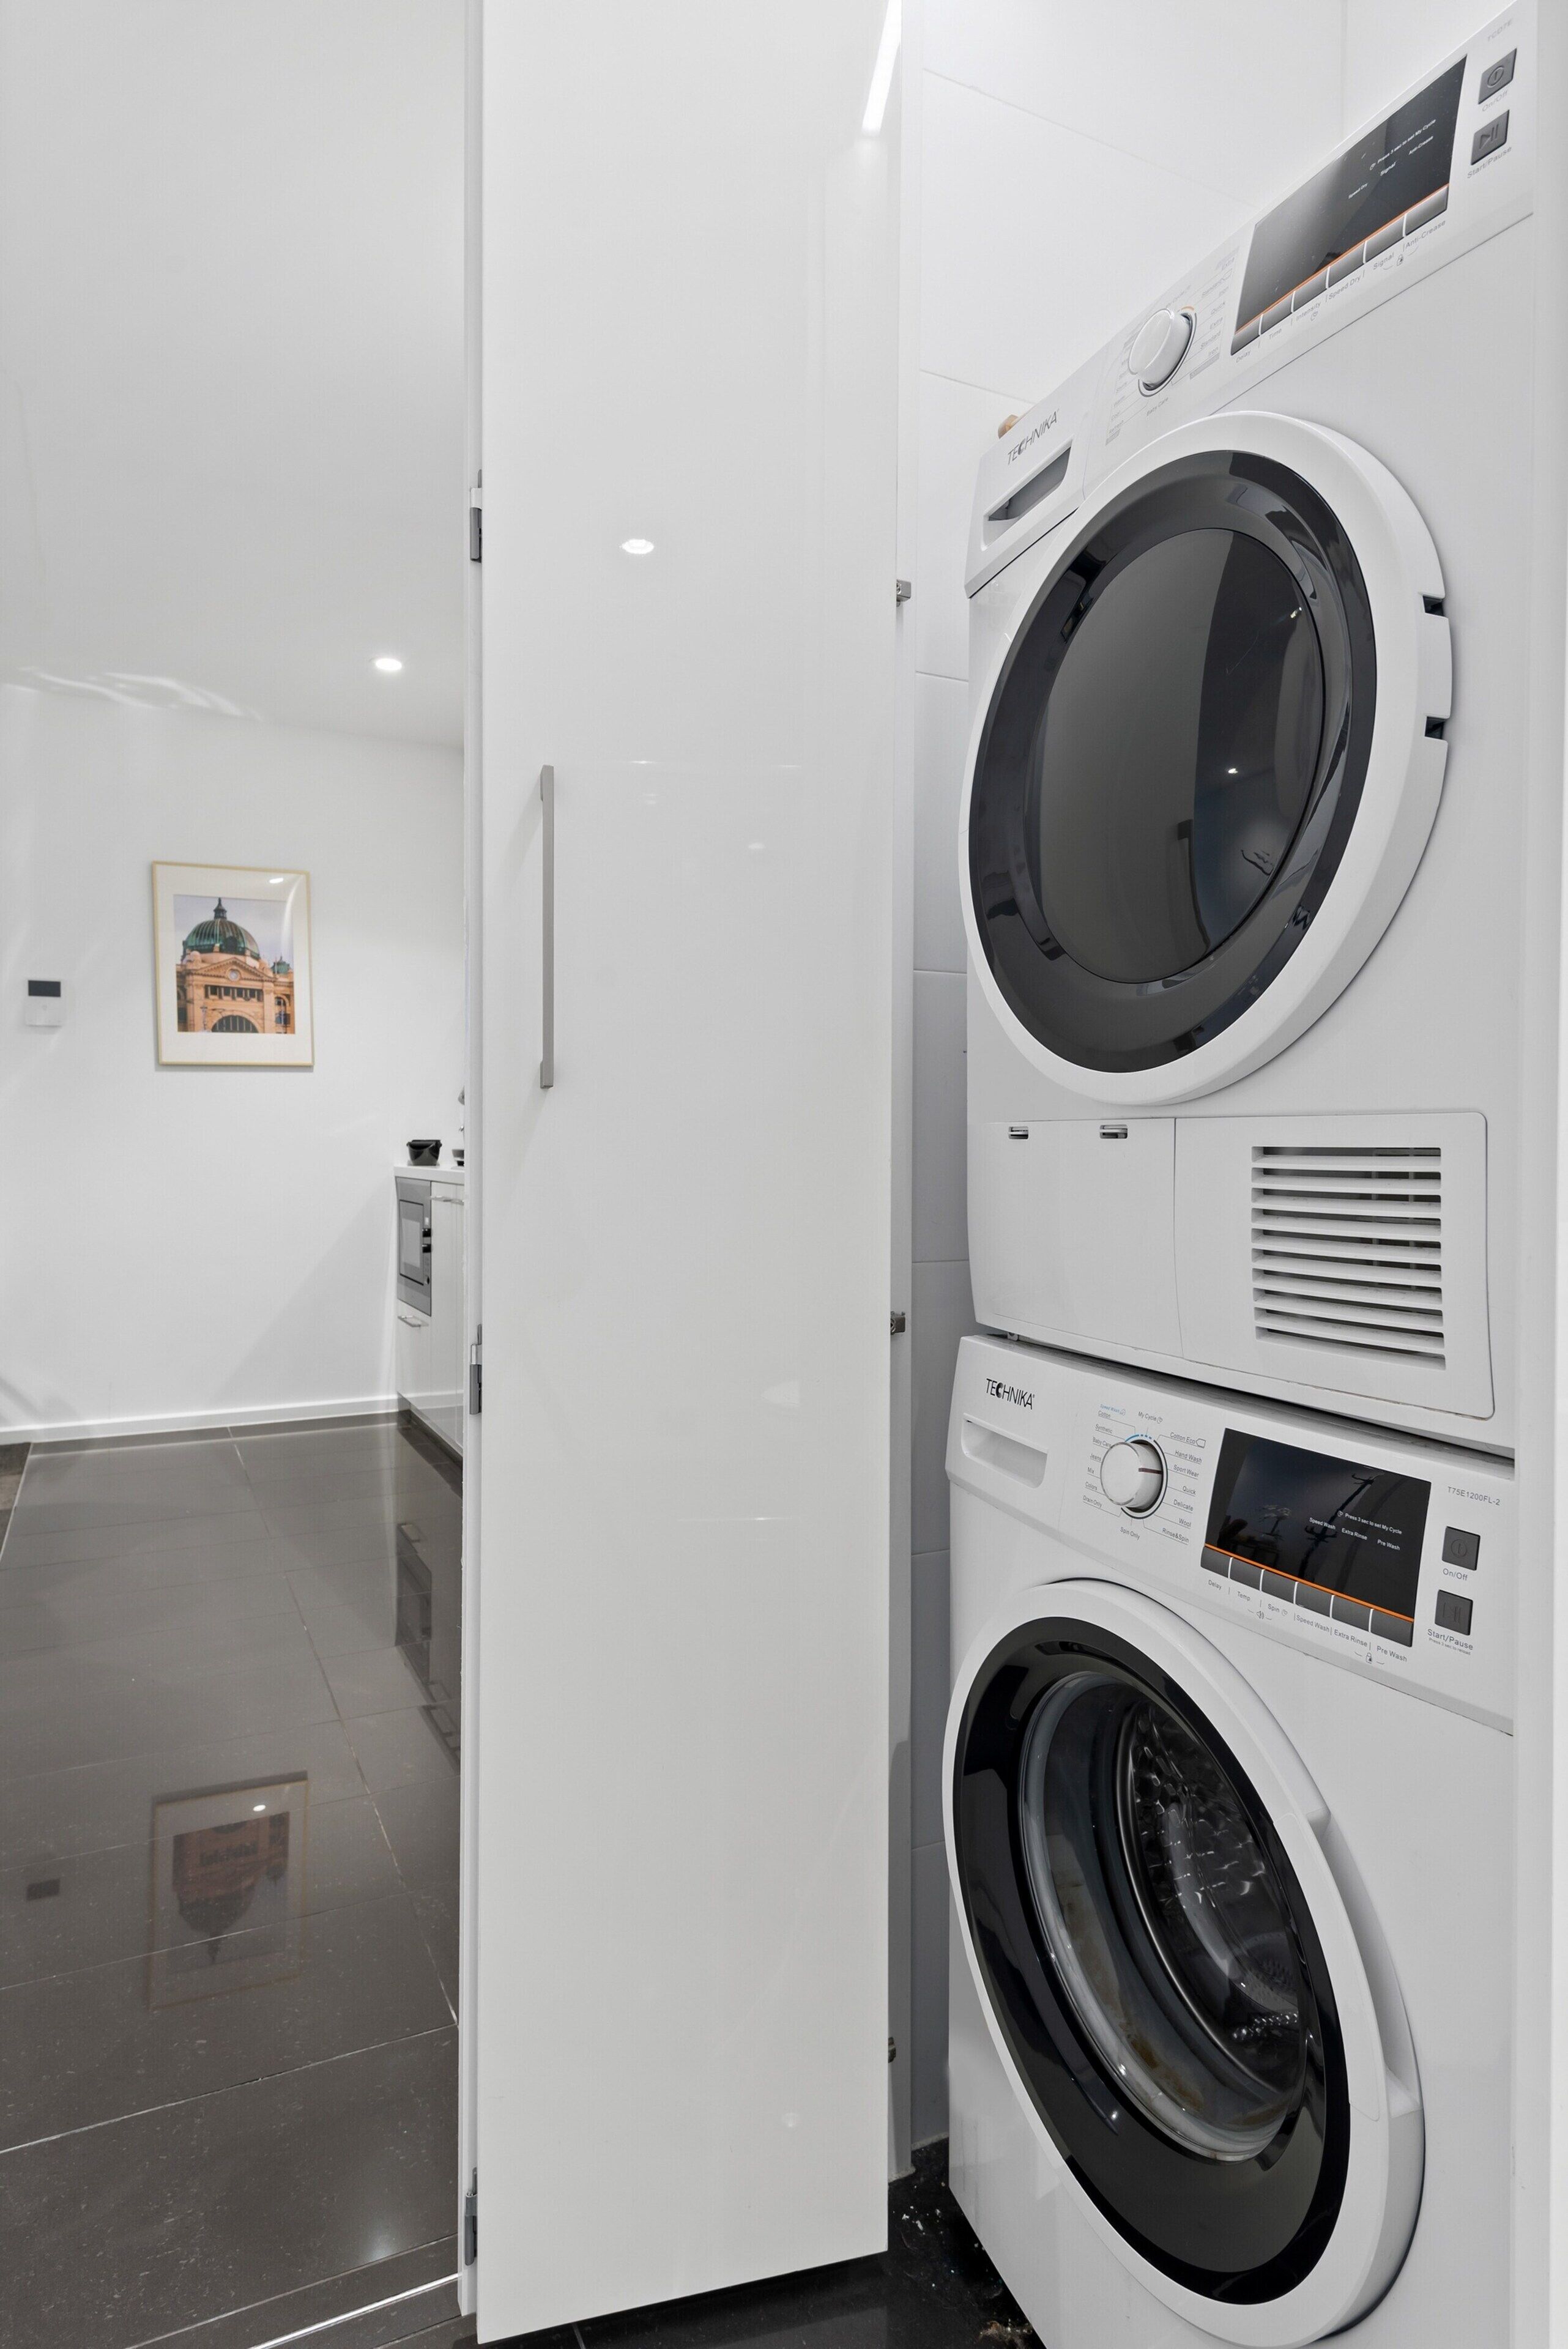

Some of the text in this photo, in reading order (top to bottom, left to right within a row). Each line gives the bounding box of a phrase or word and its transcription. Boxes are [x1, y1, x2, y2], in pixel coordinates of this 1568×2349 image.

[1482, 90, 1508, 112] On/Off
[1467, 146, 1512, 179] Start/Pause
[1405, 220, 1446, 249] Anti-Crease
[1373, 252, 1394, 270] Signal
[1329, 275, 1361, 300] Speed Dry
[1296, 301, 1321, 321] Intensity
[1269, 328, 1282, 340] Time
[1236, 351, 1251, 363] Delay
[1008, 410, 1057, 466] TECHNIKA
[986, 1378, 1033, 1410] TECHNIKA
[1098, 1410, 1111, 1419] Cotton
[1145, 1413, 1157, 1422] Cycle
[1095, 1423, 1113, 1434] Synthetic
[1093, 1436, 1102, 1446] Baby
[1170, 1432, 1185, 1442] Cotton
[1090, 1453, 1101, 1462] Jeans
[1175, 1450, 1202, 1463] Hand Wash
[1173, 1464, 1200, 1478] Sport Wear
[1085, 1482, 1098, 1491] Colors
[1183, 1485, 1196, 1495] Quick
[1083, 1494, 1102, 1508] Drain Only
[1447, 1486, 1500, 1505] T75E1200FL-2
[1173, 1499, 1194, 1512] Delicate
[1178, 1518, 1192, 1527] Wool
[1309, 1517, 1336, 1530] Speed Wash
[1120, 1527, 1140, 1541] Spin Only
[1162, 1528, 1189, 1543] Rinse&Spin
[1342, 1527, 1368, 1540] Extra Rinse
[1389, 1526, 1402, 1535] Cycle
[1386, 1542, 1400, 1551] Wash
[1443, 1568, 1468, 1581] On/Off
[1208, 1579, 1222, 1590] Delay
[1237, 1591, 1250, 1601] Temp
[1268, 1603, 1280, 1612] Spin
[1296, 1614, 1330, 1633] Speed Wash
[1334, 1629, 1368, 1647] Extra Rinse
[1427, 1628, 1474, 1650] Start/Pause
[1377, 1646, 1407, 1662] Pre Wash
